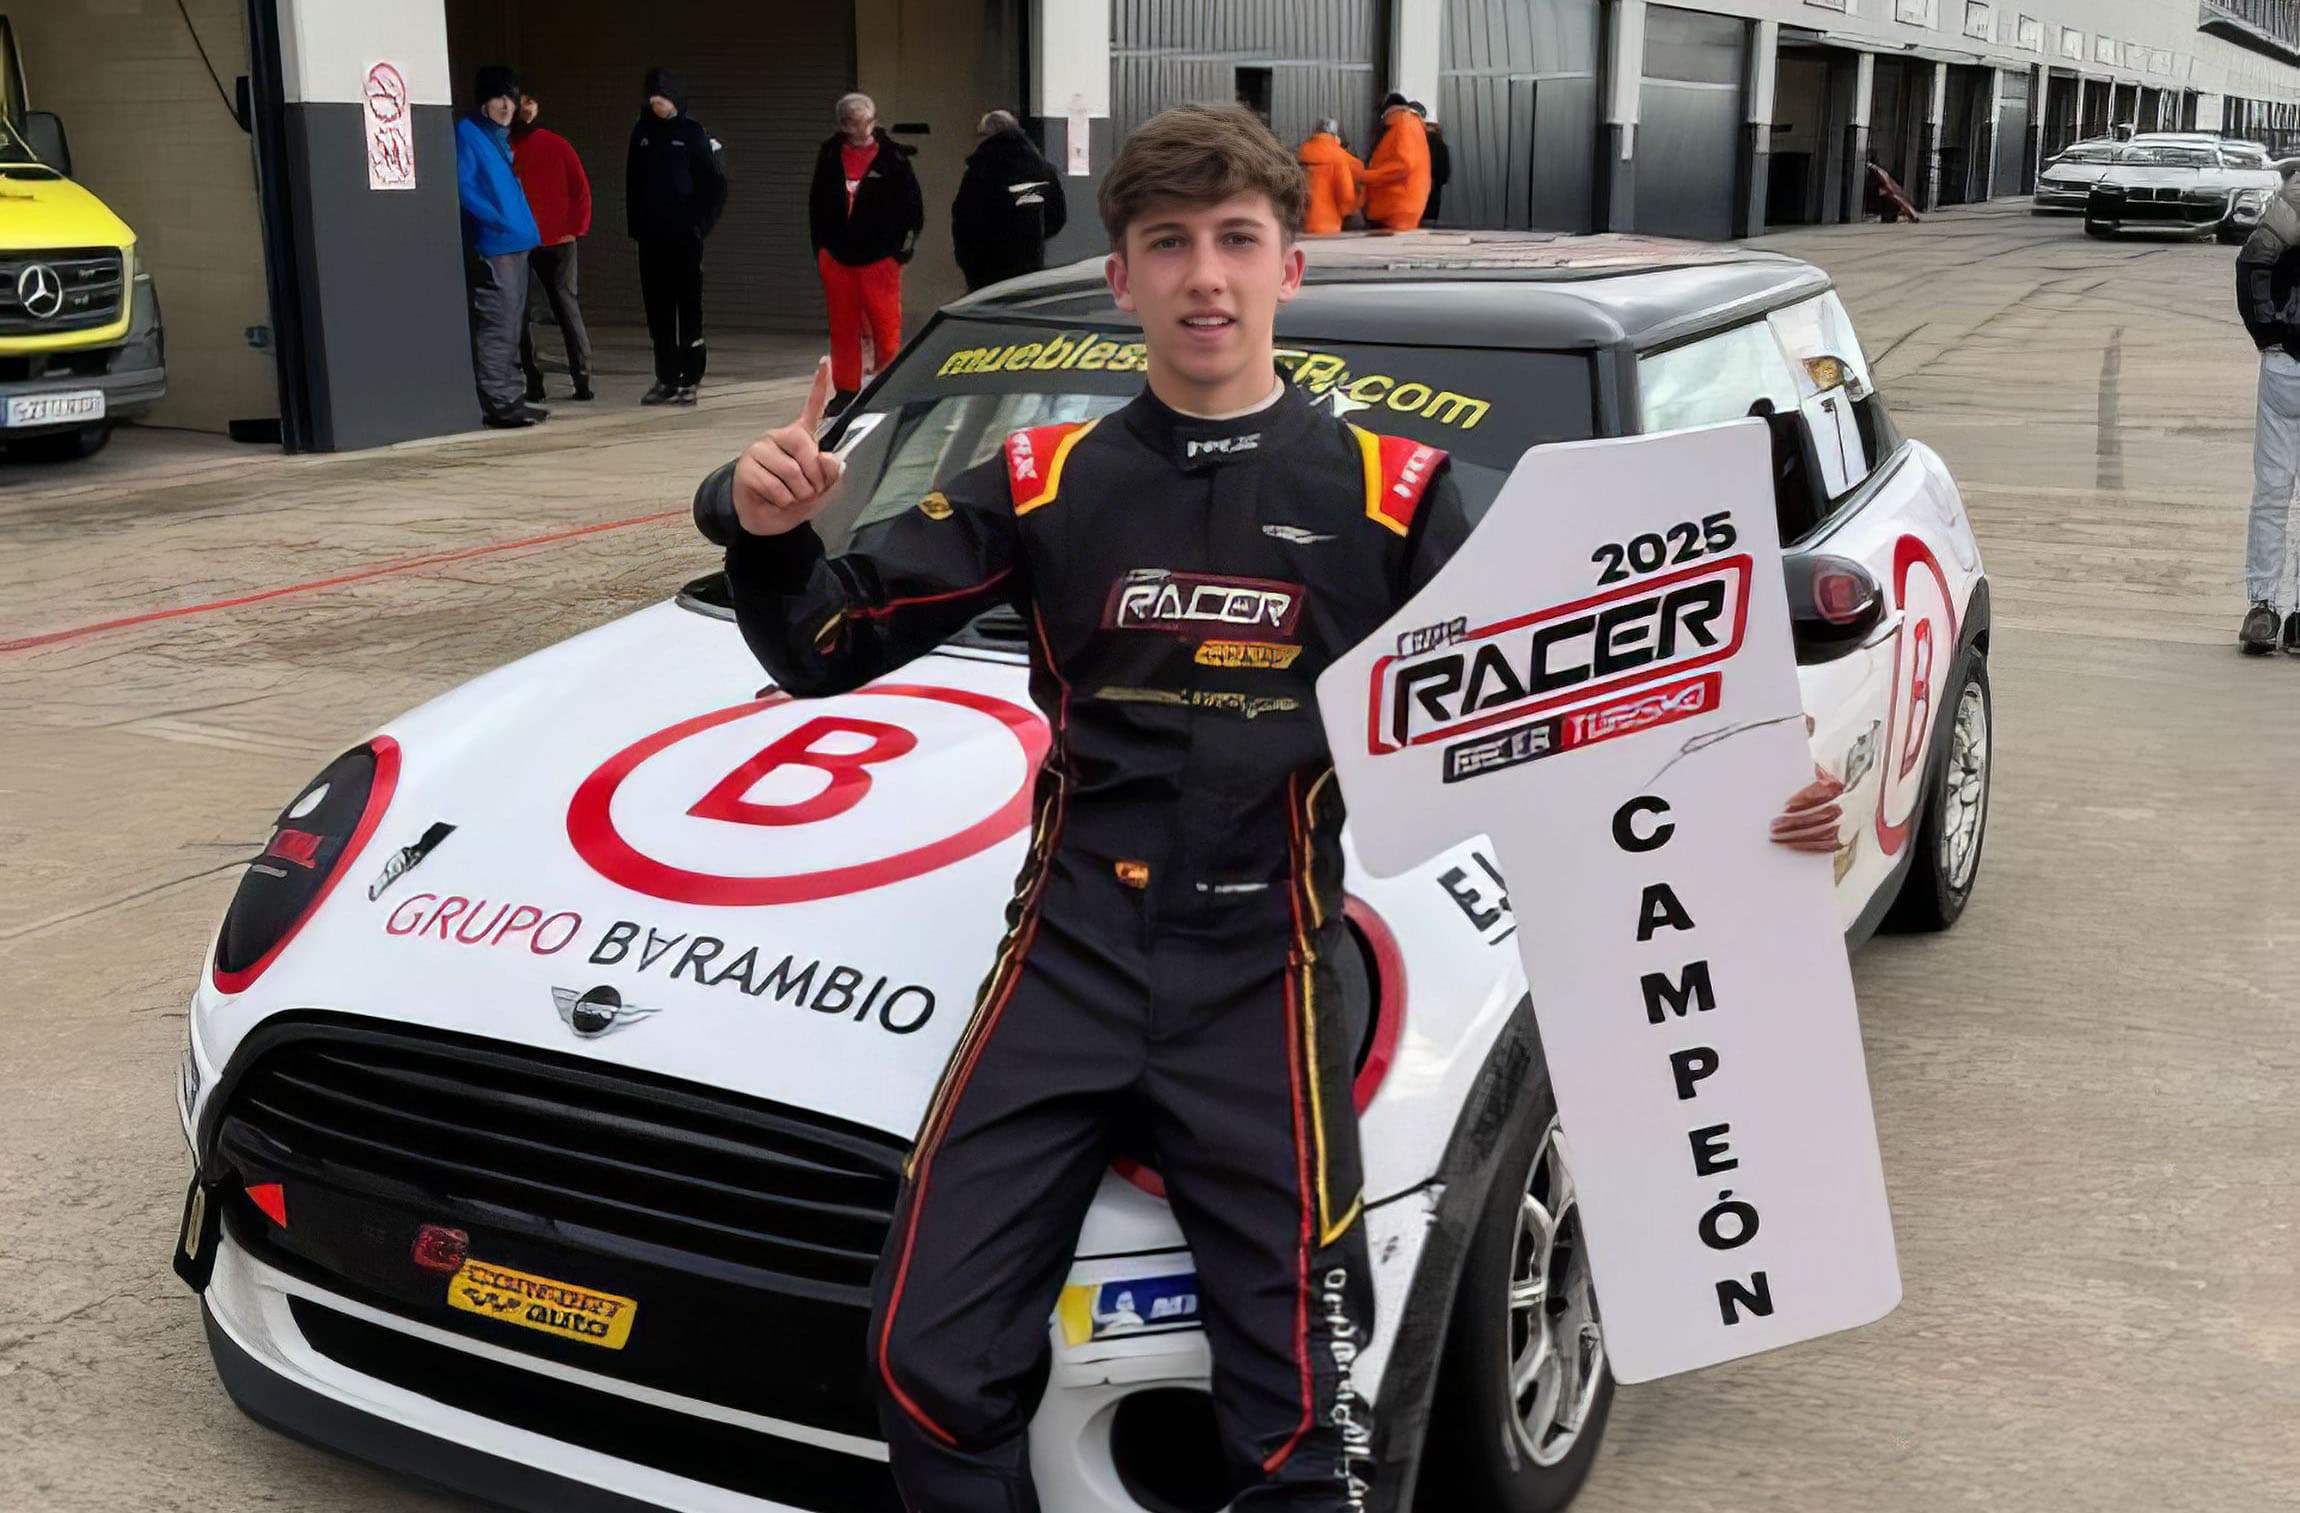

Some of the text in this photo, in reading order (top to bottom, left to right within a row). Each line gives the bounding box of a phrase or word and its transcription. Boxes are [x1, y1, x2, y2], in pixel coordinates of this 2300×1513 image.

[1591, 511, 1738, 586] 2025
[1117, 583, 1292, 628] RACER
[1393, 579, 1726, 748] RACER
[686, 715, 919, 826] B
[385, 892, 936, 1035] GRUPO BARAMBIO
[1611, 795, 1775, 1326] CAMPEÓN
[525, 1303, 610, 1338] auto
